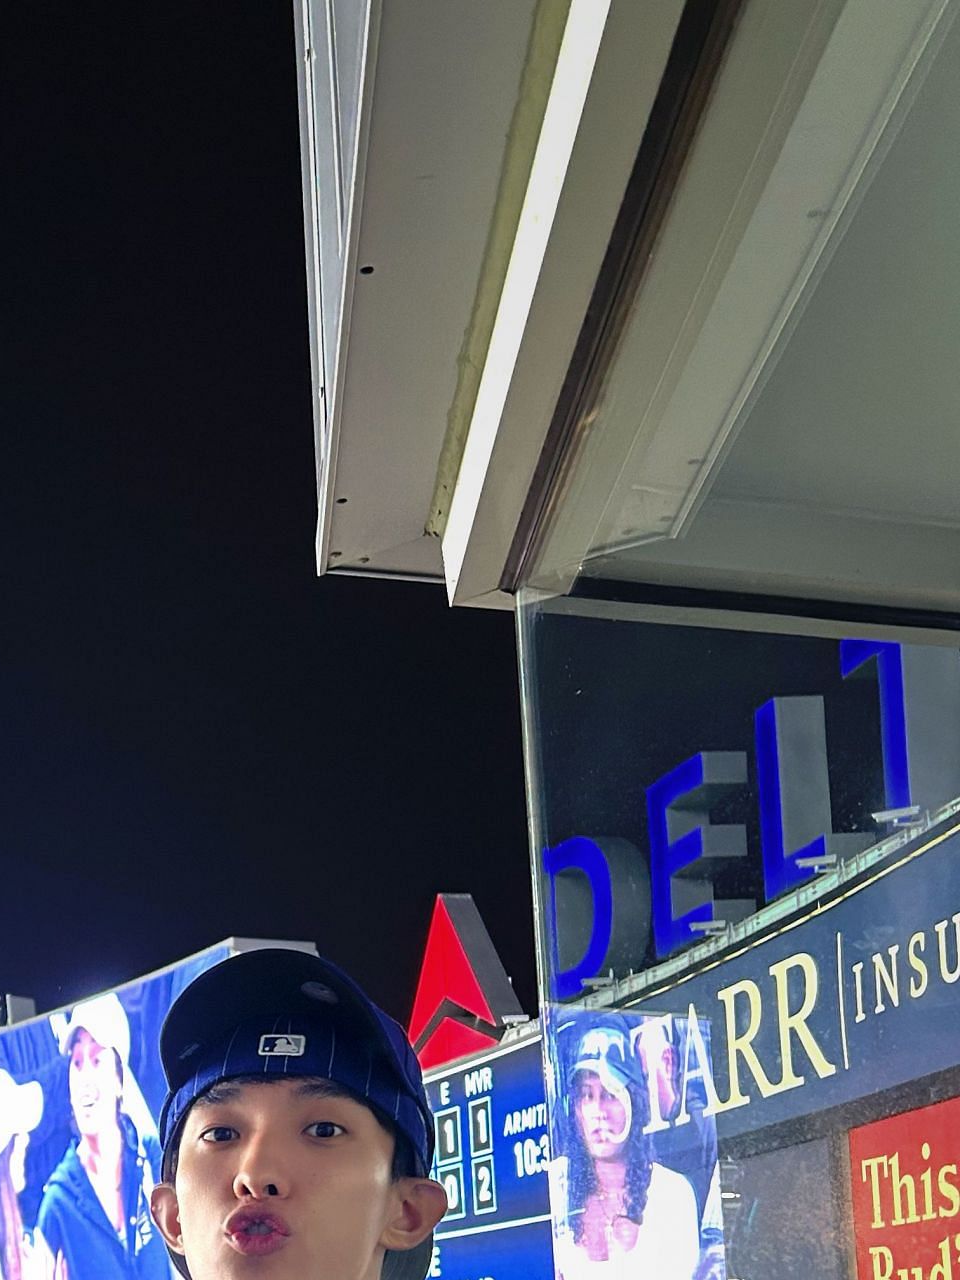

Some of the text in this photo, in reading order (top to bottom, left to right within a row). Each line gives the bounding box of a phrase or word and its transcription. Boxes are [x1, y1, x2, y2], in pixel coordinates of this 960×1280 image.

[575, 951, 838, 1145] STARR
[440, 1067, 493, 1106] E MVR
[444, 1108, 488, 1154] 1 1
[477, 1166, 492, 1202] 2
[861, 1142, 960, 1229] This
